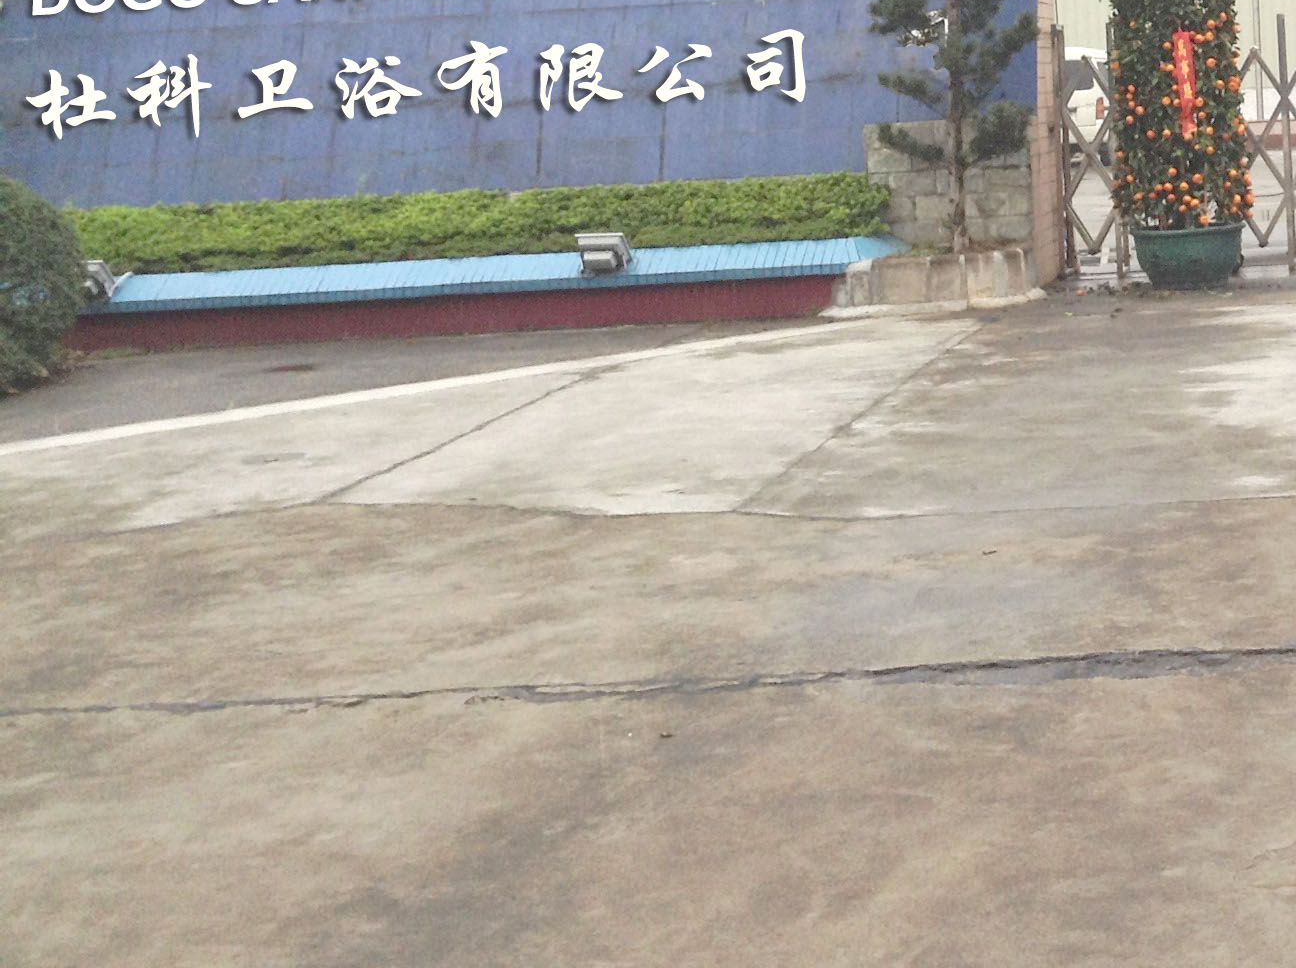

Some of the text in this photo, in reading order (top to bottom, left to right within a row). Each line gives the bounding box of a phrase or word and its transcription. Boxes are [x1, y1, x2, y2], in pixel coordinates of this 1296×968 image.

[25, 28, 806, 140] 杜科卫浴有限公司
